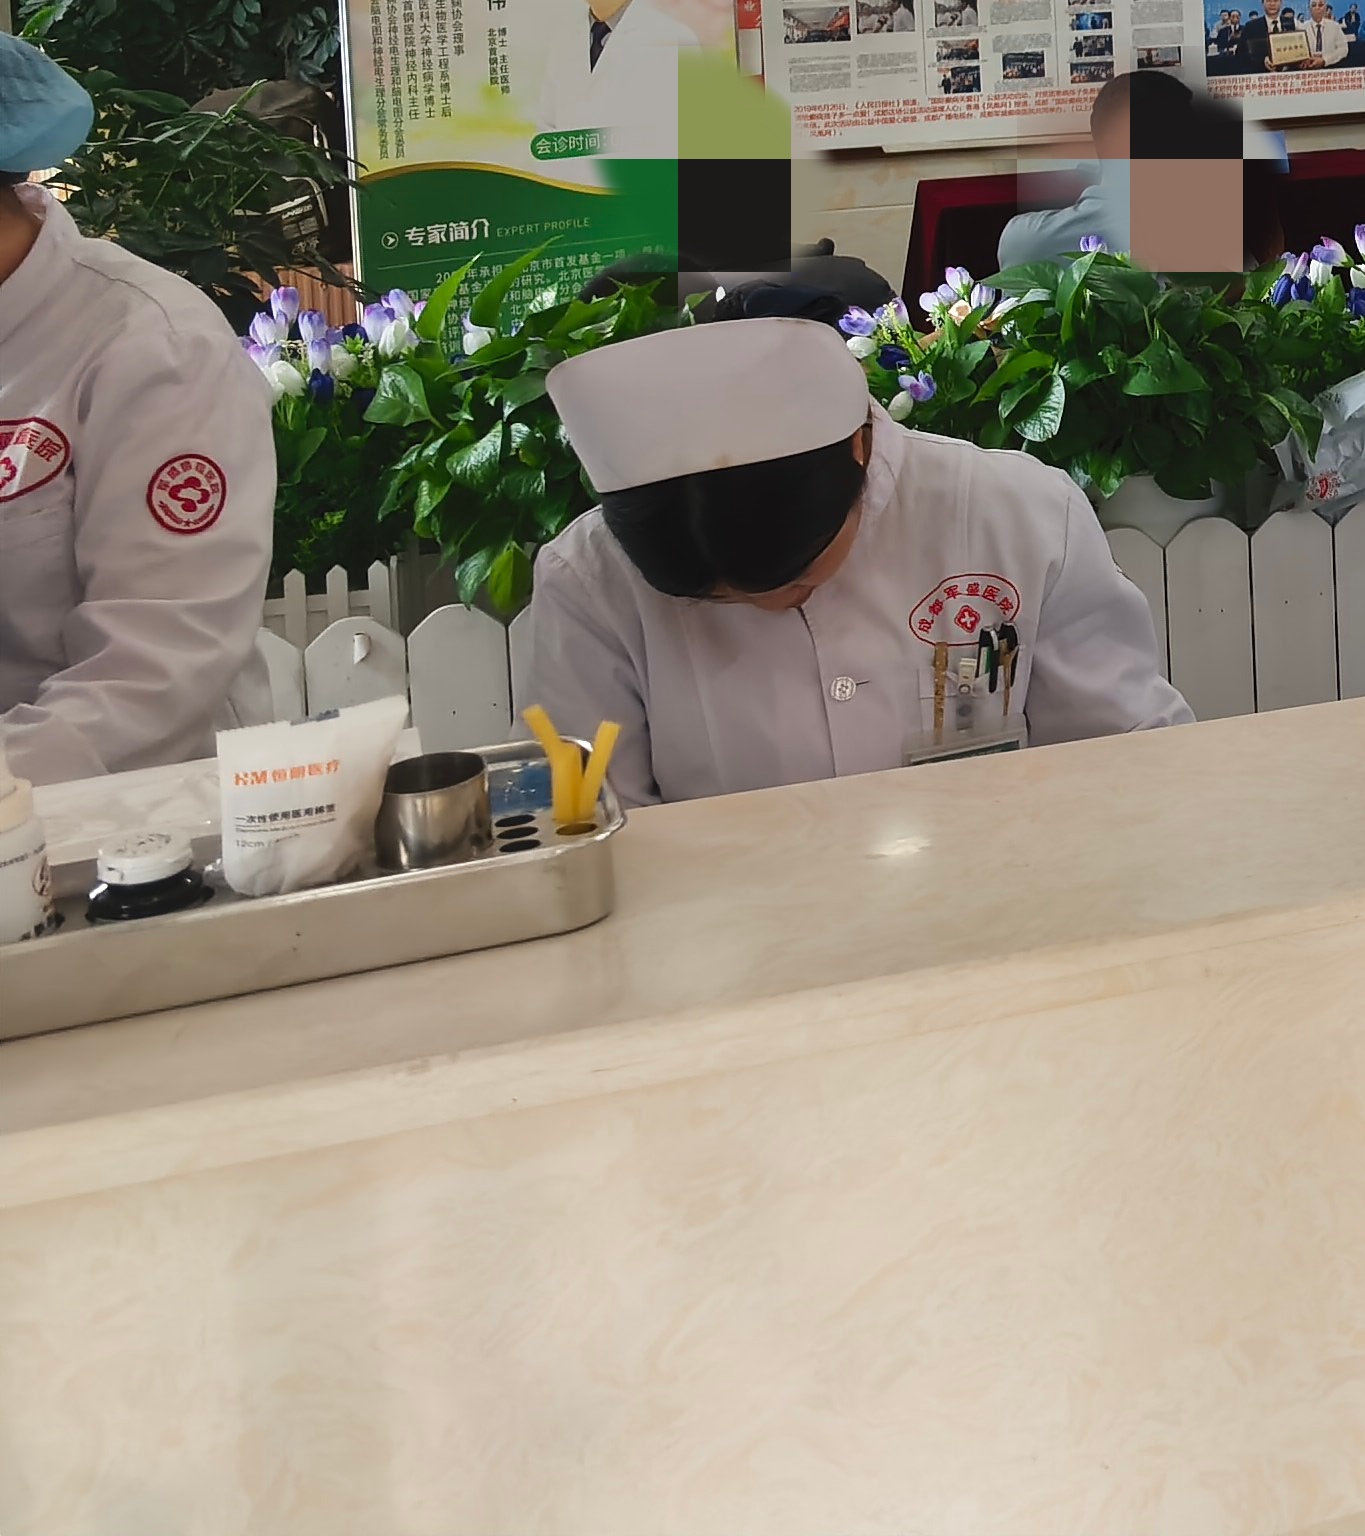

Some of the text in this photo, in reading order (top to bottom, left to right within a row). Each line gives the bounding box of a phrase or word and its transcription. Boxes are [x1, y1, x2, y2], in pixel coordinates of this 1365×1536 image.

[498, 27, 508, 48] 博士
[488, 28, 501, 86] 北京首钢医院
[404, 218, 490, 247] 专家简介
[497, 217, 590, 238] EXPERT PROFILE
[918, 582, 1014, 634] 成都军盛医院
